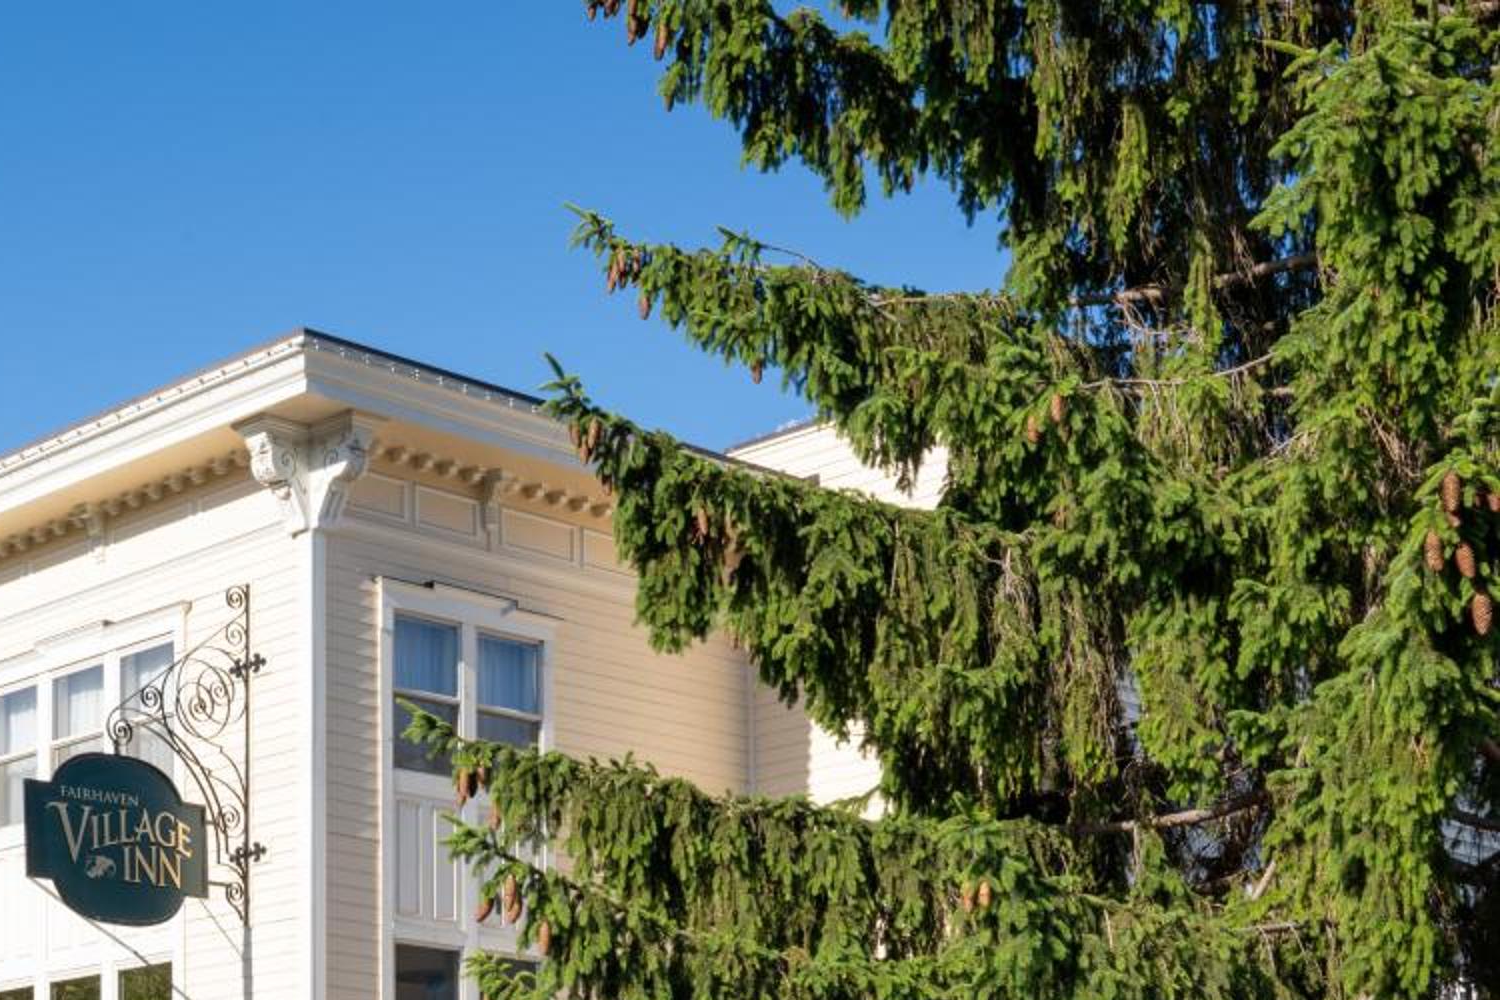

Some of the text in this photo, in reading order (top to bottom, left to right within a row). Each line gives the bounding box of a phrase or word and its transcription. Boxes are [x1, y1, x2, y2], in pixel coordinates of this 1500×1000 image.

[60, 785, 139, 806] FAIRHAVEN
[45, 801, 194, 864] VILLAGE
[122, 845, 182, 889] INN
